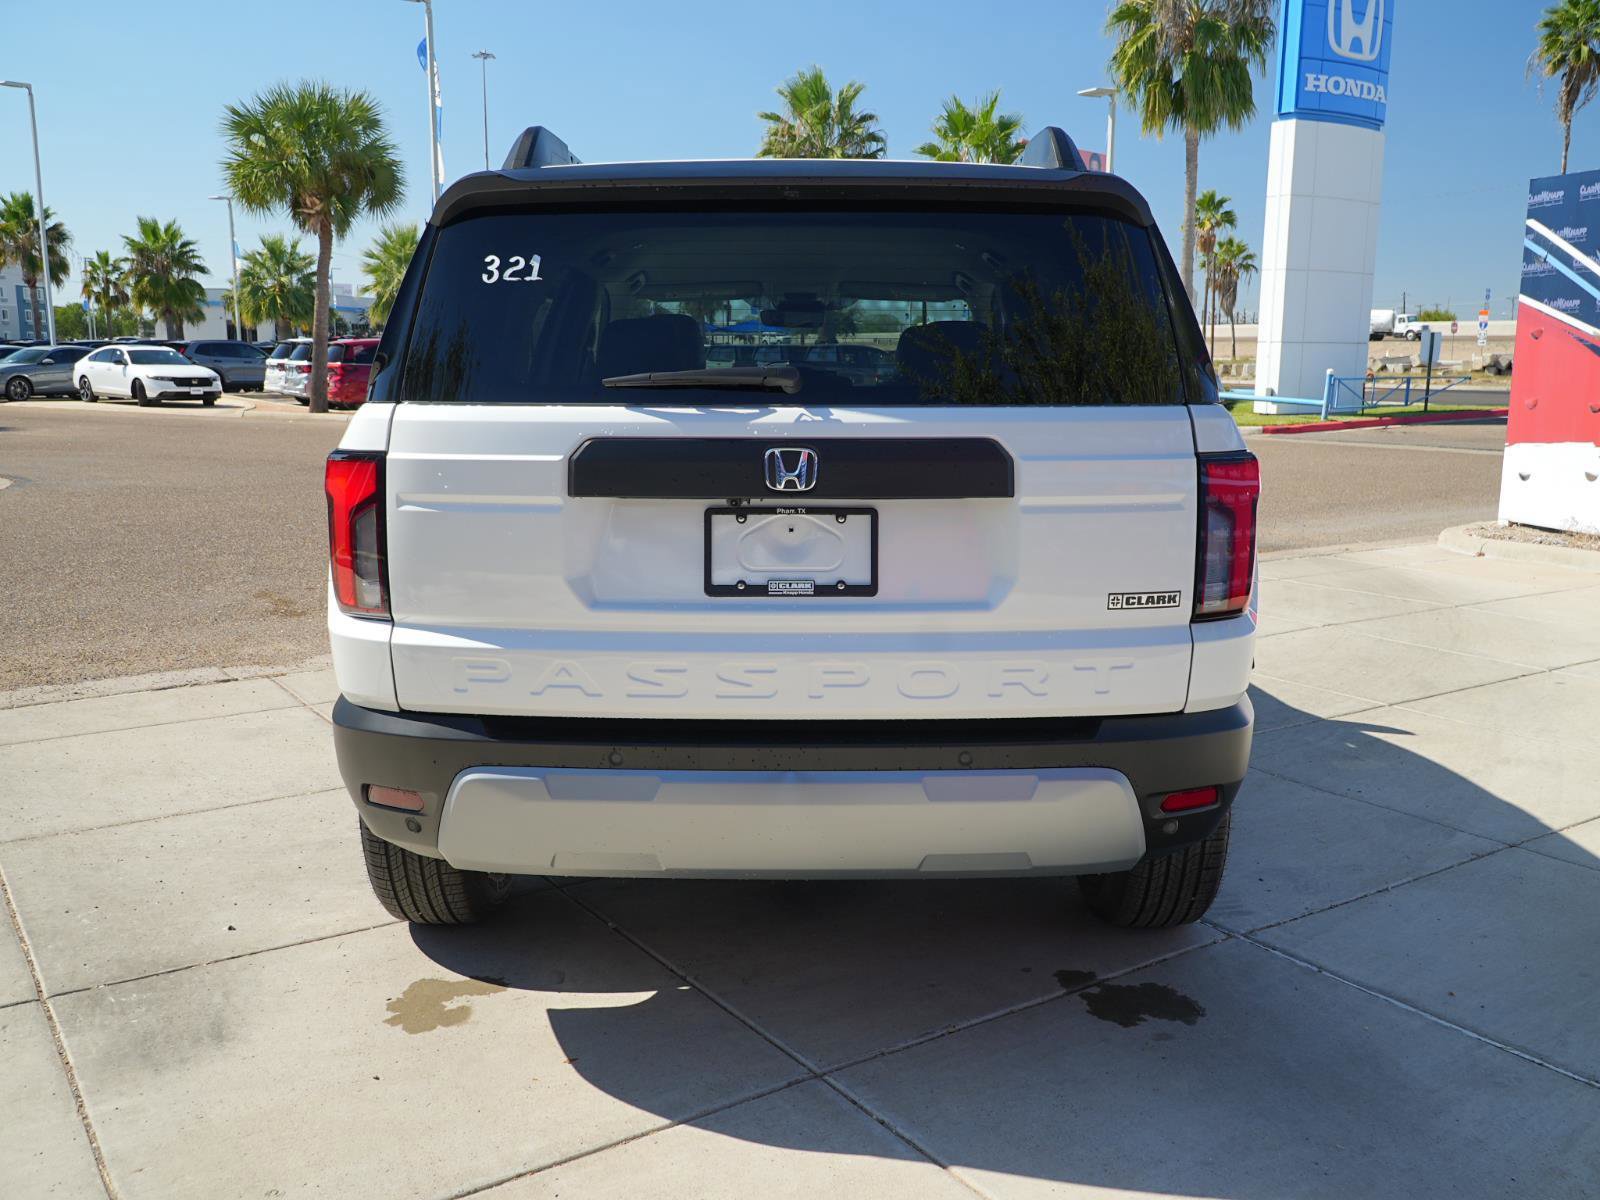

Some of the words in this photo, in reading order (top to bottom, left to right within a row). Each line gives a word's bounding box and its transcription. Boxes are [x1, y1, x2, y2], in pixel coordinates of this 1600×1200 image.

[1304, 73, 1387, 103] HONDA
[482, 254, 543, 283] 321
[1125, 594, 1178, 606] CLARK
[452, 656, 1134, 699] PASSPORT
